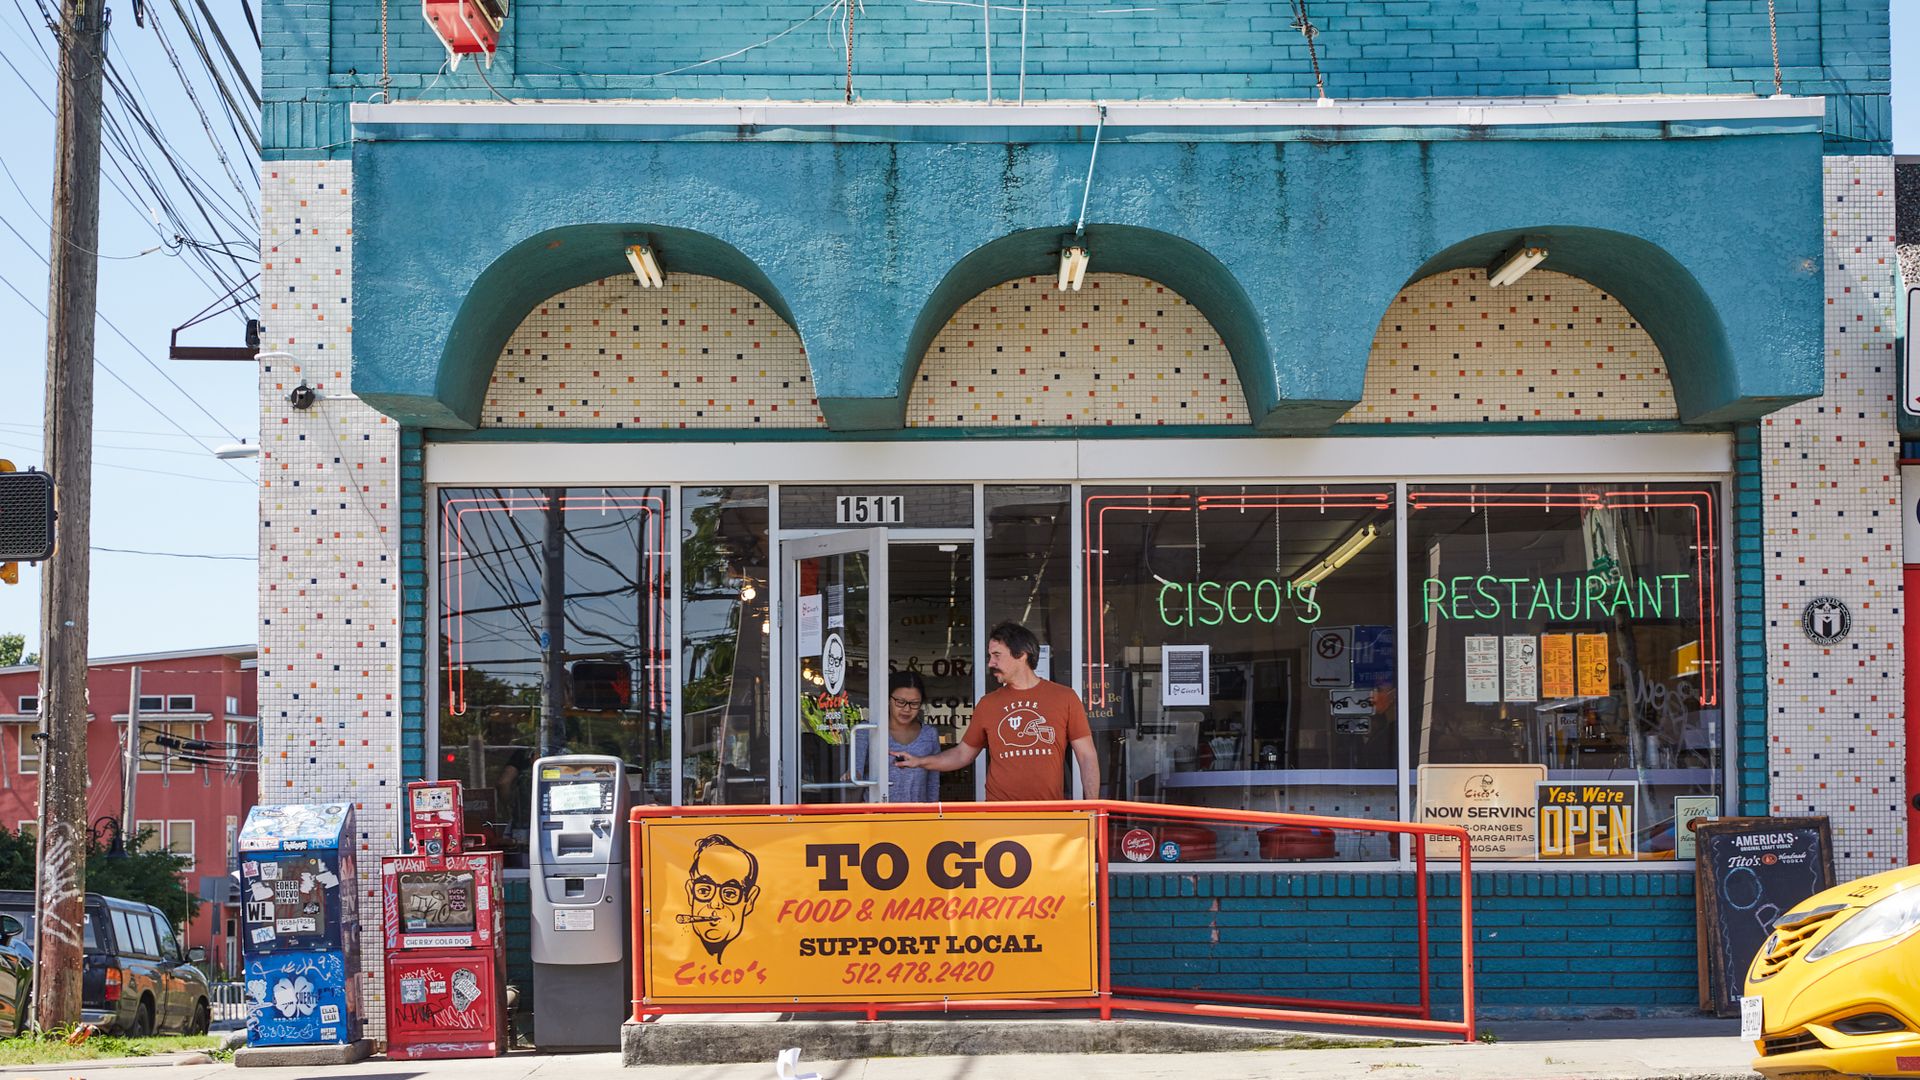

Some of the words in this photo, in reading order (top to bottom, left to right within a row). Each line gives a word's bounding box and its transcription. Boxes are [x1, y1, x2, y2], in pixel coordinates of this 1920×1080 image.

[841, 497, 900, 522] 1511
[1160, 579, 1321, 627] CISCO'S
[1423, 575, 1690, 623] RESTAURANT
[1003, 701, 1038, 712] TEXAS
[1000, 748, 1053, 759] LONGHORNS
[1464, 789, 1499, 798] Cisco's
[1549, 788, 1578, 803] Yes,
[1583, 787, 1624, 802] We're
[1425, 807, 1463, 818] NOW
[1684, 807, 1712, 816] Tito's
[1540, 805, 1631, 856] OPEN
[1736, 833, 1795, 847] AMERICA'S
[1778, 852, 1807, 860] Handmade
[805, 841, 910, 892] TO
[926, 840, 1033, 889] GO
[276, 890, 298, 898] NUEVO
[248, 903, 273, 921] WL
[777, 898, 852, 923] FOOD
[856, 897, 873, 921] &
[881, 895, 1066, 921] MARGARITAS!
[406, 938, 433, 946] CHERRY
[455, 937, 469, 945] DOG
[799, 936, 941, 957] SUPPORT
[946, 934, 1043, 955] LOCAL
[674, 959, 768, 986] Cisco's
[842, 960, 995, 985] 512.478.2420
